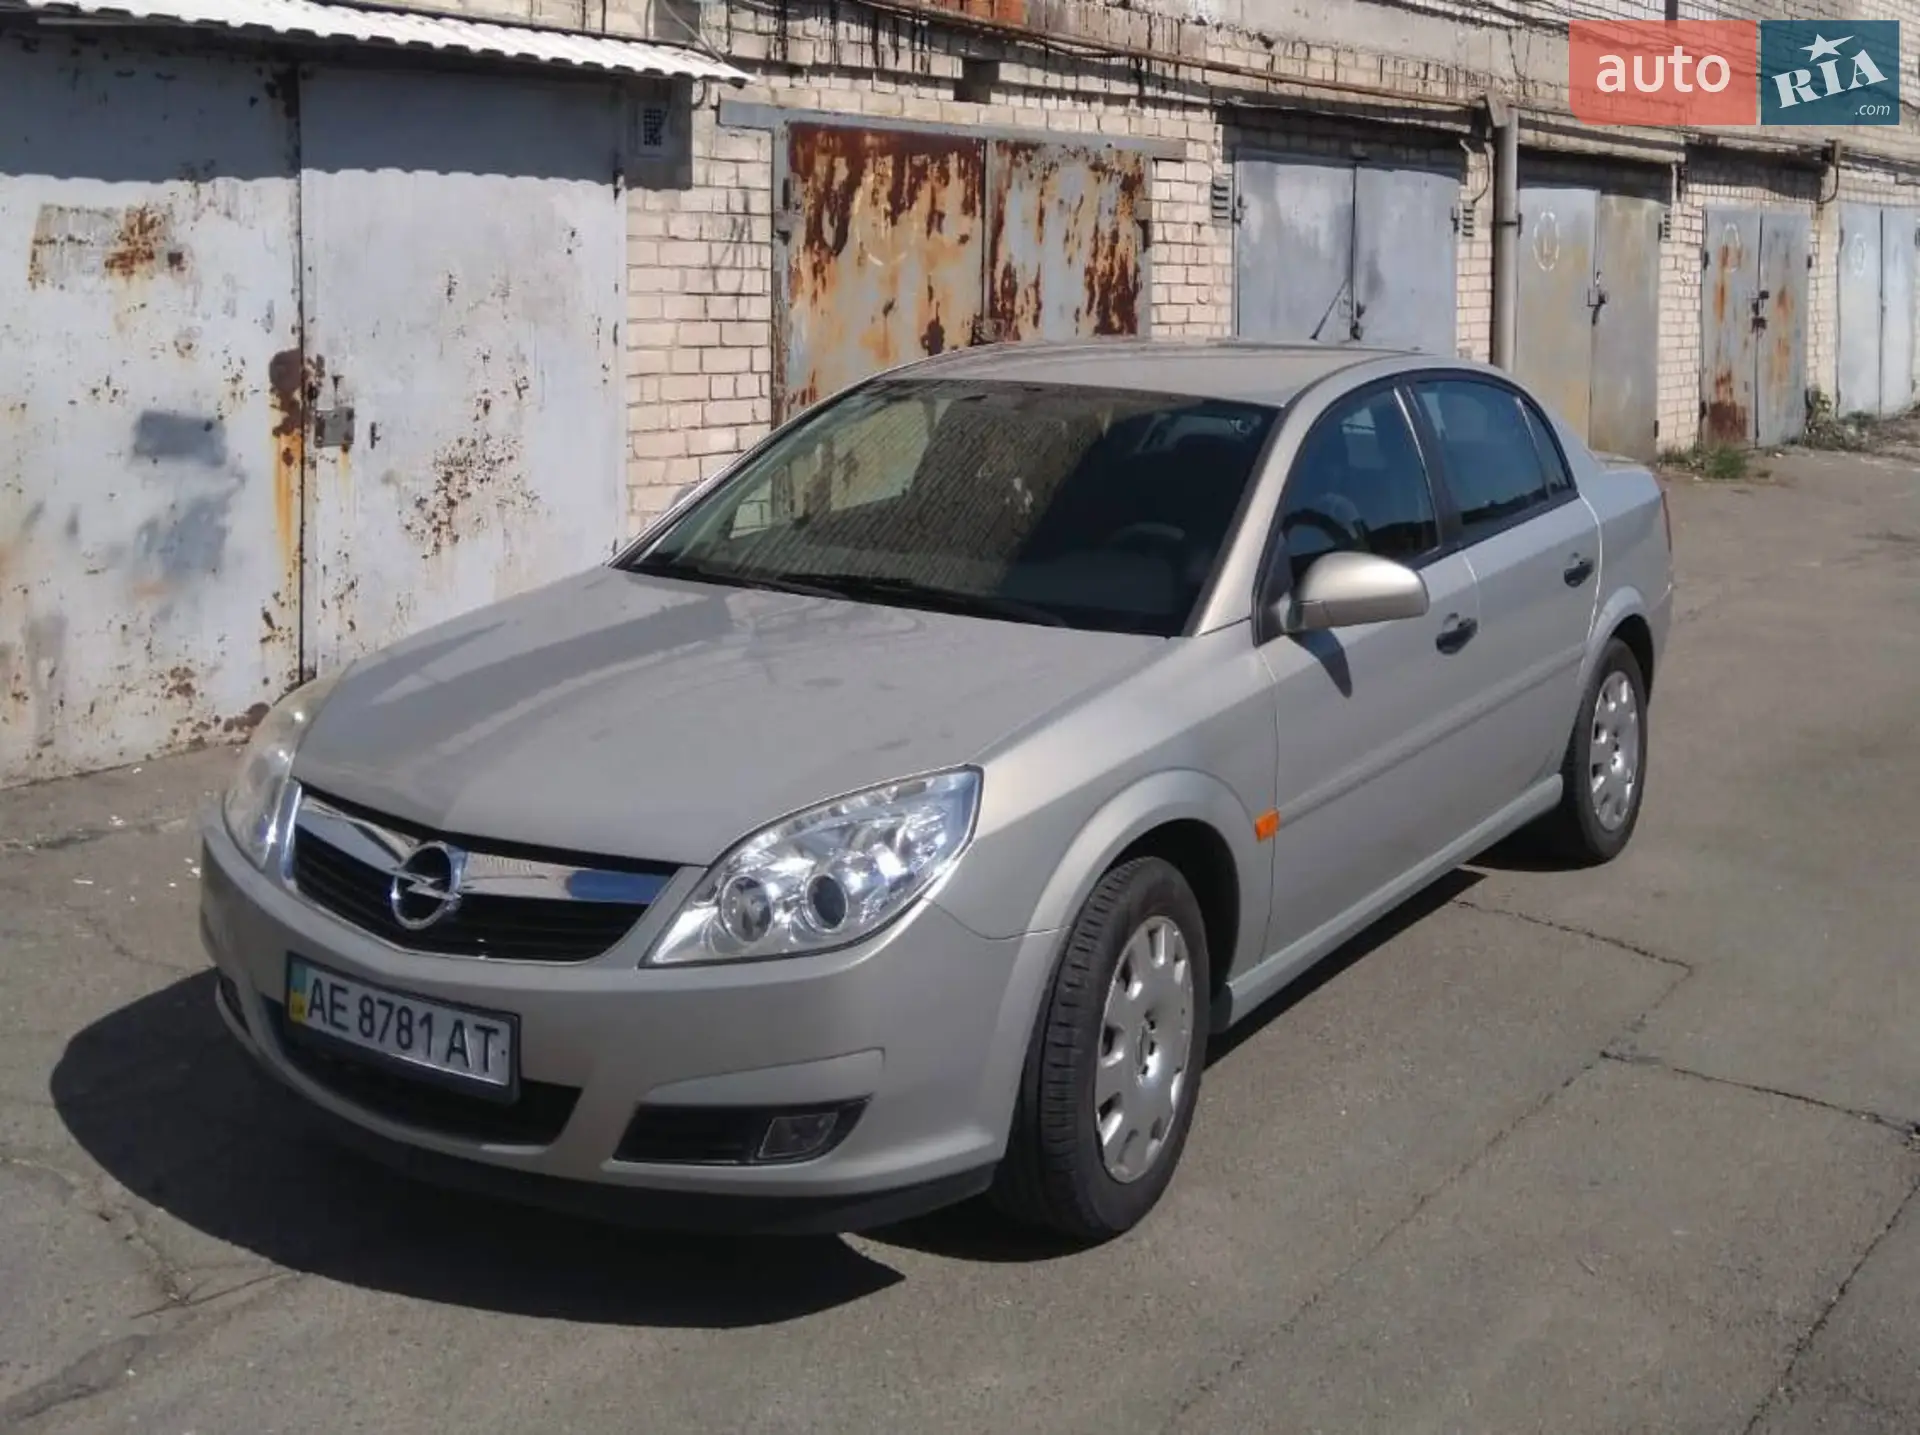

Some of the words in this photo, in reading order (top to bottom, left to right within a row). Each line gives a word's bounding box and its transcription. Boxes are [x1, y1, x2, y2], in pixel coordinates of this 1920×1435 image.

[308, 978, 349, 1032] AE
[357, 993, 434, 1058] 8781
[445, 1019, 500, 1073] AT
